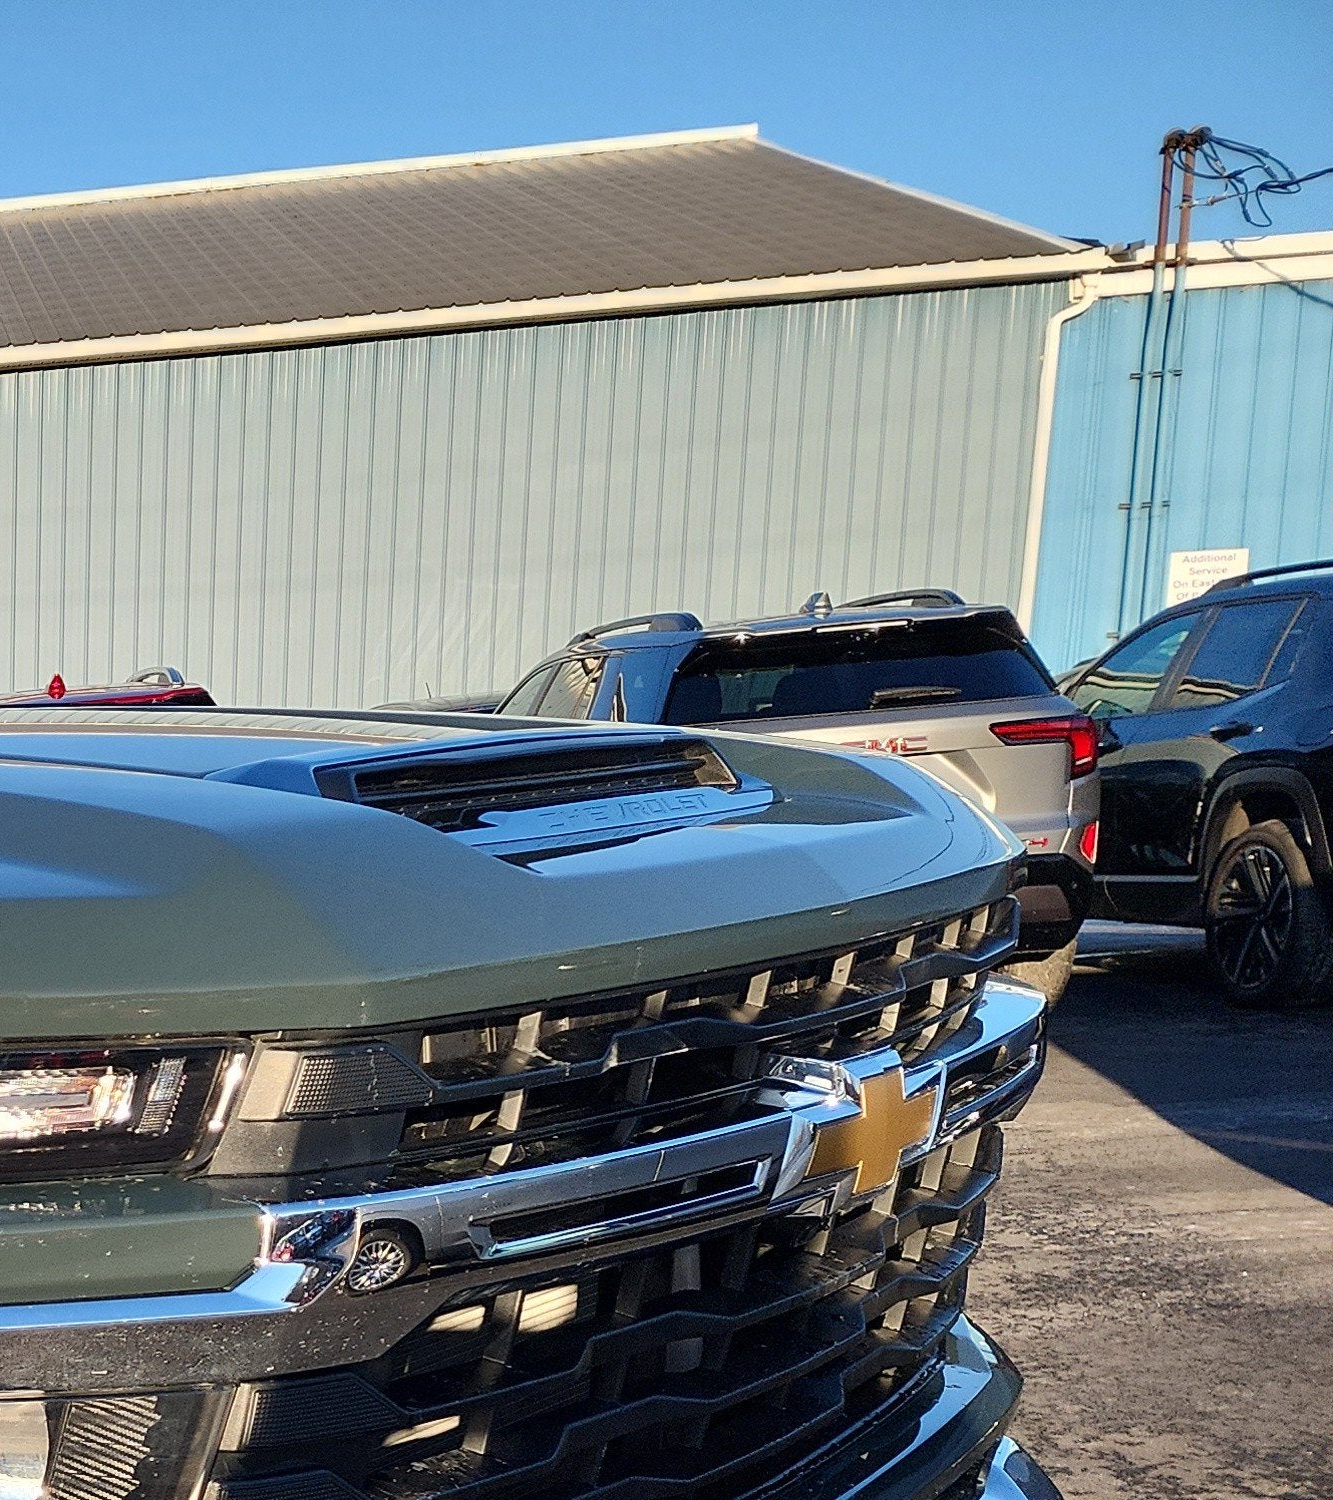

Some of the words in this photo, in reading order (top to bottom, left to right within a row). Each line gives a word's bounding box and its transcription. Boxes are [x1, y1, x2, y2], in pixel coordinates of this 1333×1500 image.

[1182, 553, 1236, 563] Additional
[1189, 567, 1228, 576] Service
[1173, 580, 1188, 588] On
[1177, 592, 1188, 600] Of
[537, 793, 709, 829] CHEVROLET
